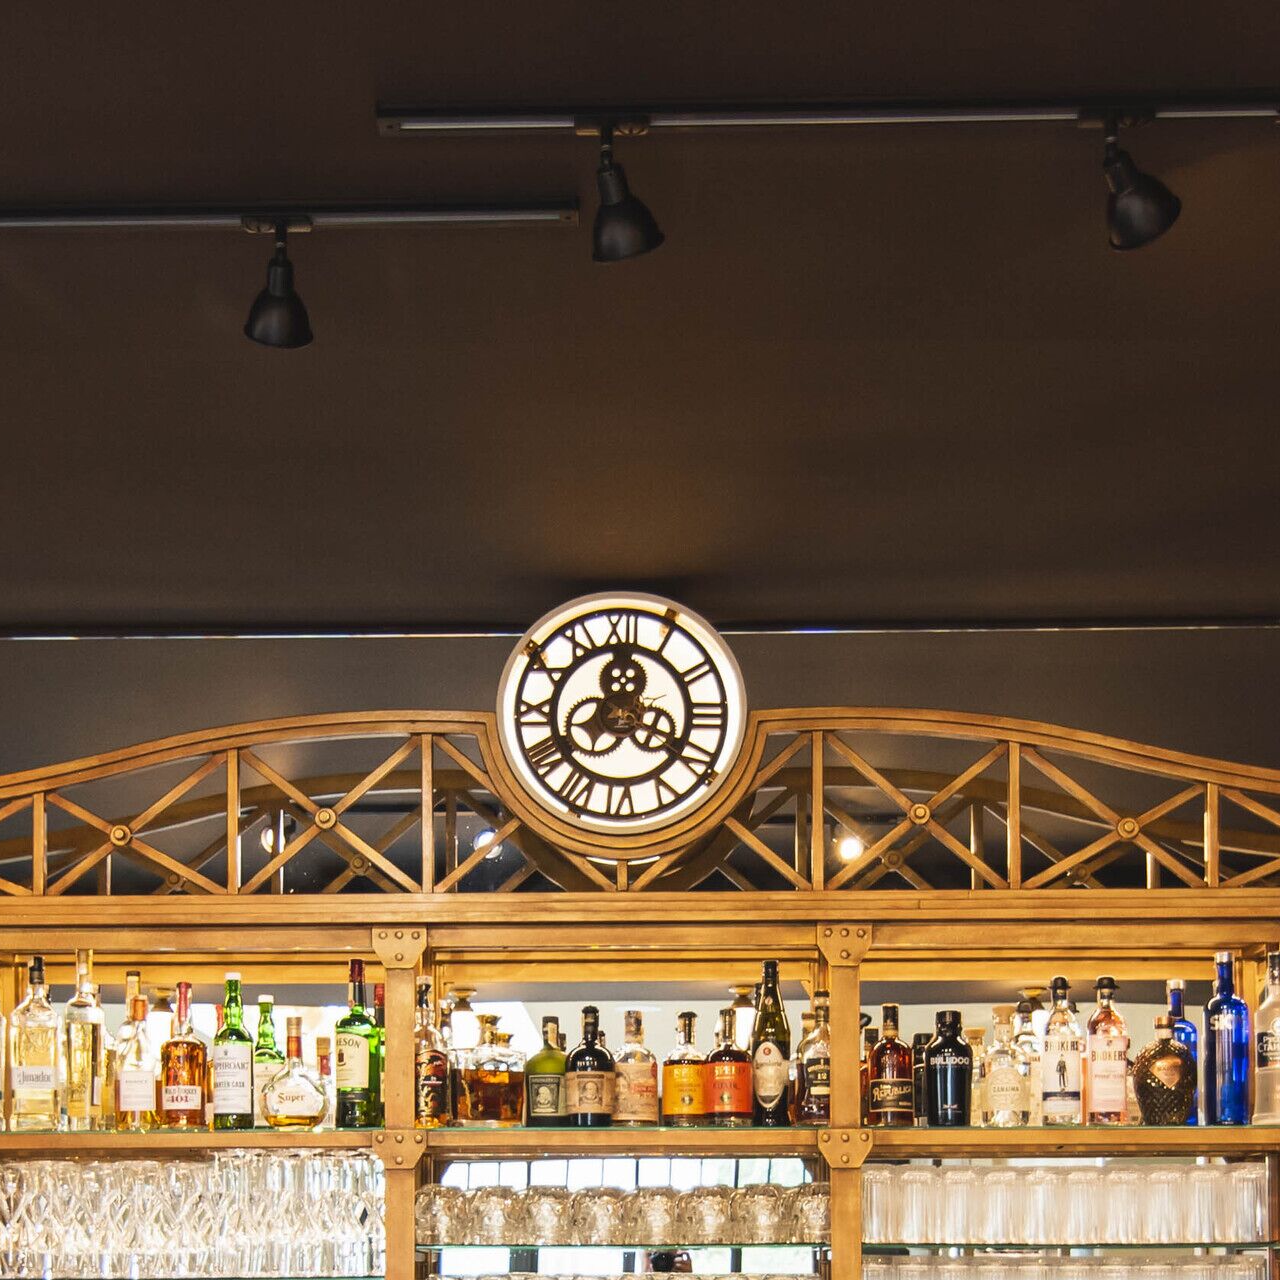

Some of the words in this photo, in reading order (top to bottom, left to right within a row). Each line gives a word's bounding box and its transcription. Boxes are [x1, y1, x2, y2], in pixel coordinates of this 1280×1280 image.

[606, 614, 638, 645] XII
[680, 658, 713, 683] II
[521, 702, 552, 725] IX
[692, 702, 722, 729] III
[526, 737, 562, 775] VIII
[560, 771, 593, 808] VII
[607, 785, 635, 815] VI
[657, 776, 684, 805] V
[930, 1055, 970, 1065] BULLDOG
[277, 1092, 306, 1104] Super
